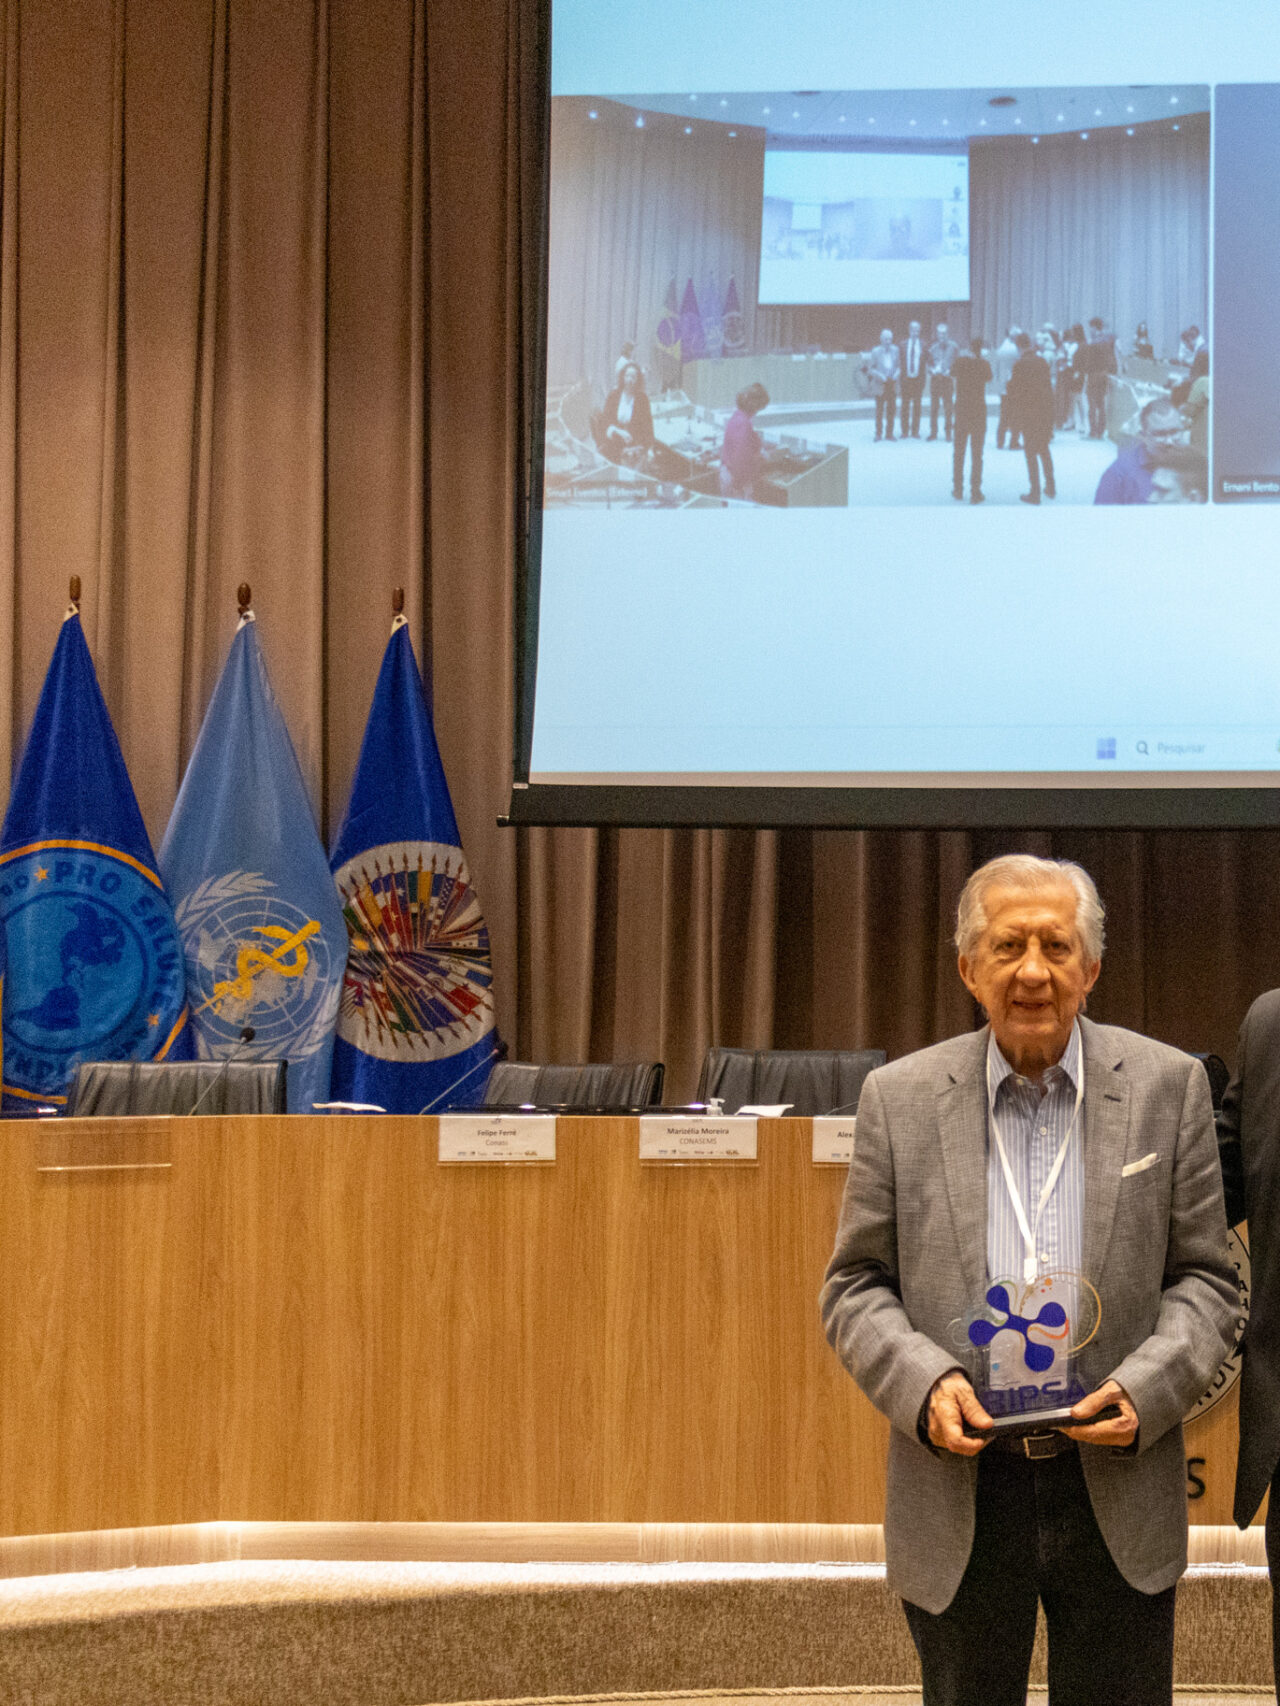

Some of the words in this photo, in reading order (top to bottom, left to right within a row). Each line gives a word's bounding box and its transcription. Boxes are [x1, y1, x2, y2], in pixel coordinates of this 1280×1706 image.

[54, 861, 122, 894] PRO
[477, 1129, 498, 1137] Felipe
[983, 1379, 1087, 1416] RIPSA
